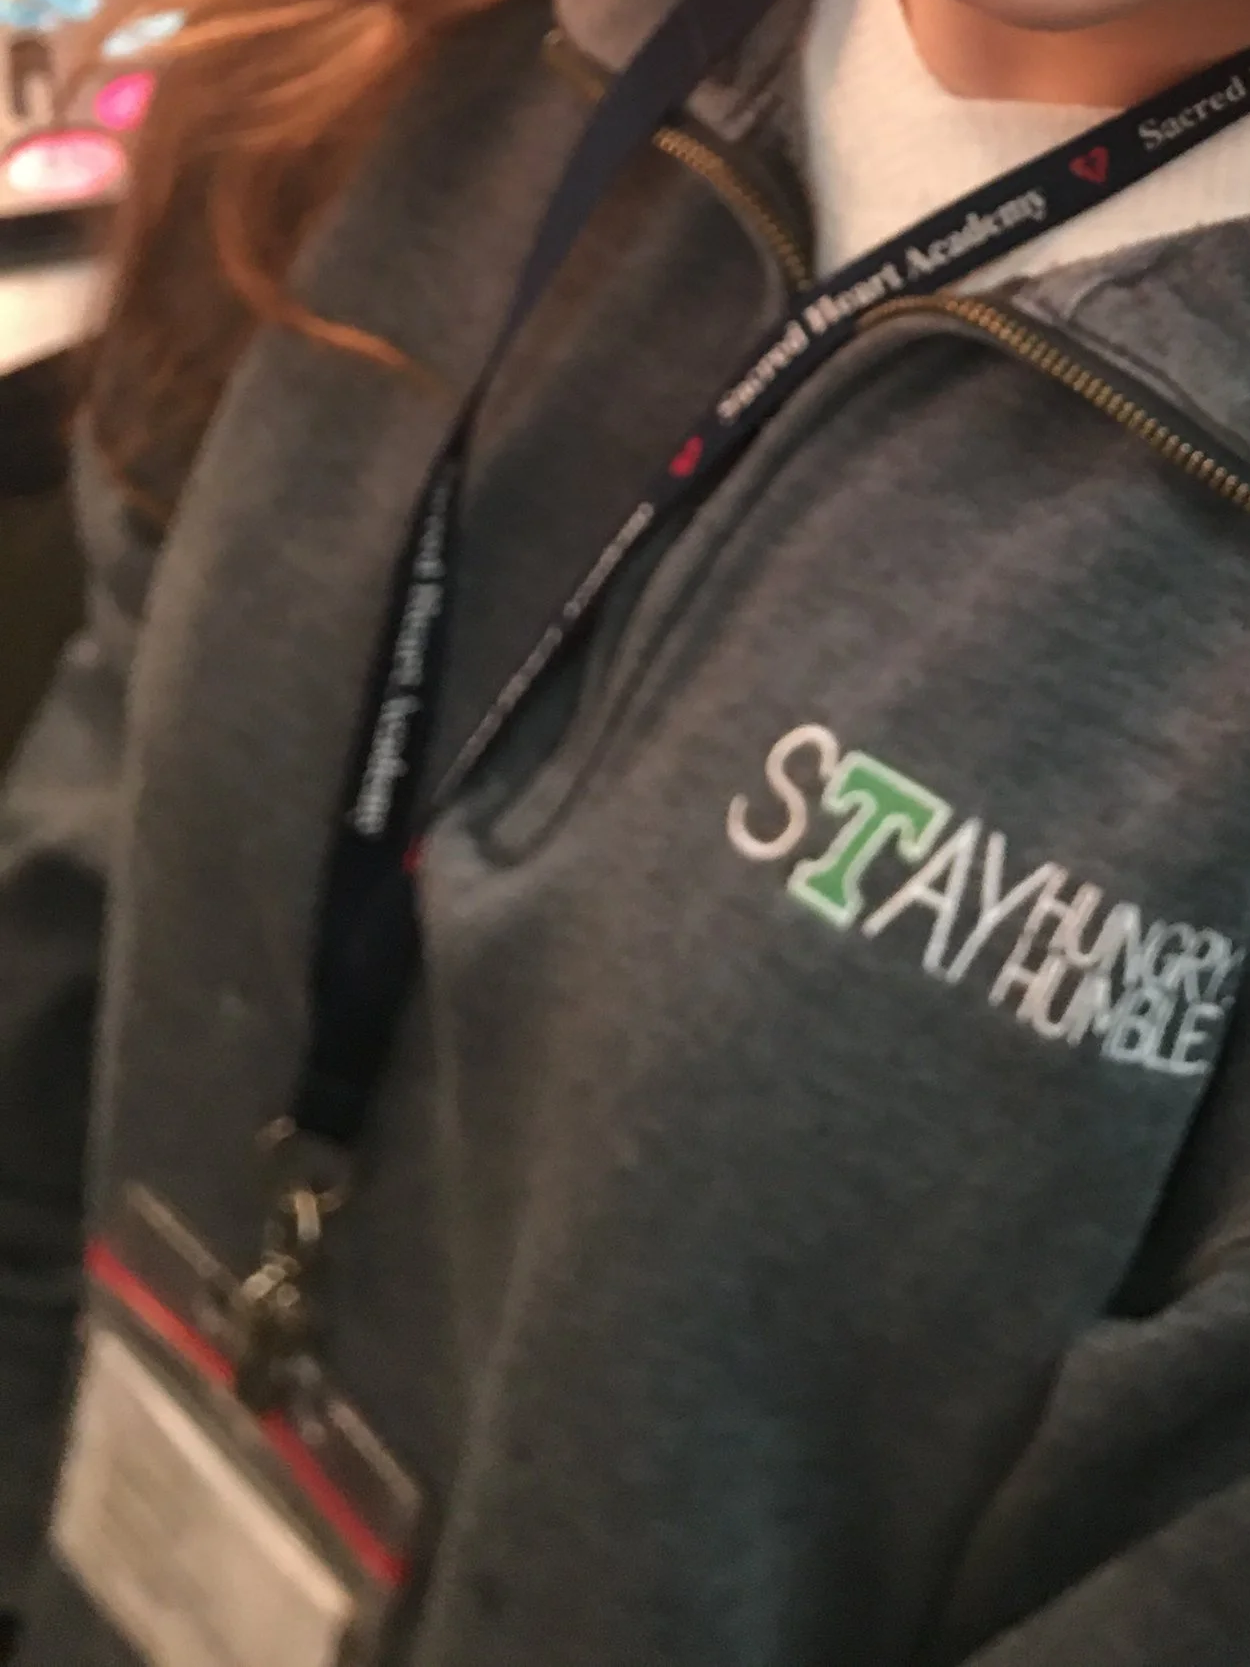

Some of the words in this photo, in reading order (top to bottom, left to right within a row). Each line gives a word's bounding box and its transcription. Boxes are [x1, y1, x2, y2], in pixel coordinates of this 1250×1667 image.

[1137, 75, 1247, 151] Sacred
[803, 262, 903, 334] Heart
[904, 187, 1047, 280] Academy
[726, 722, 1062, 986] STAY
